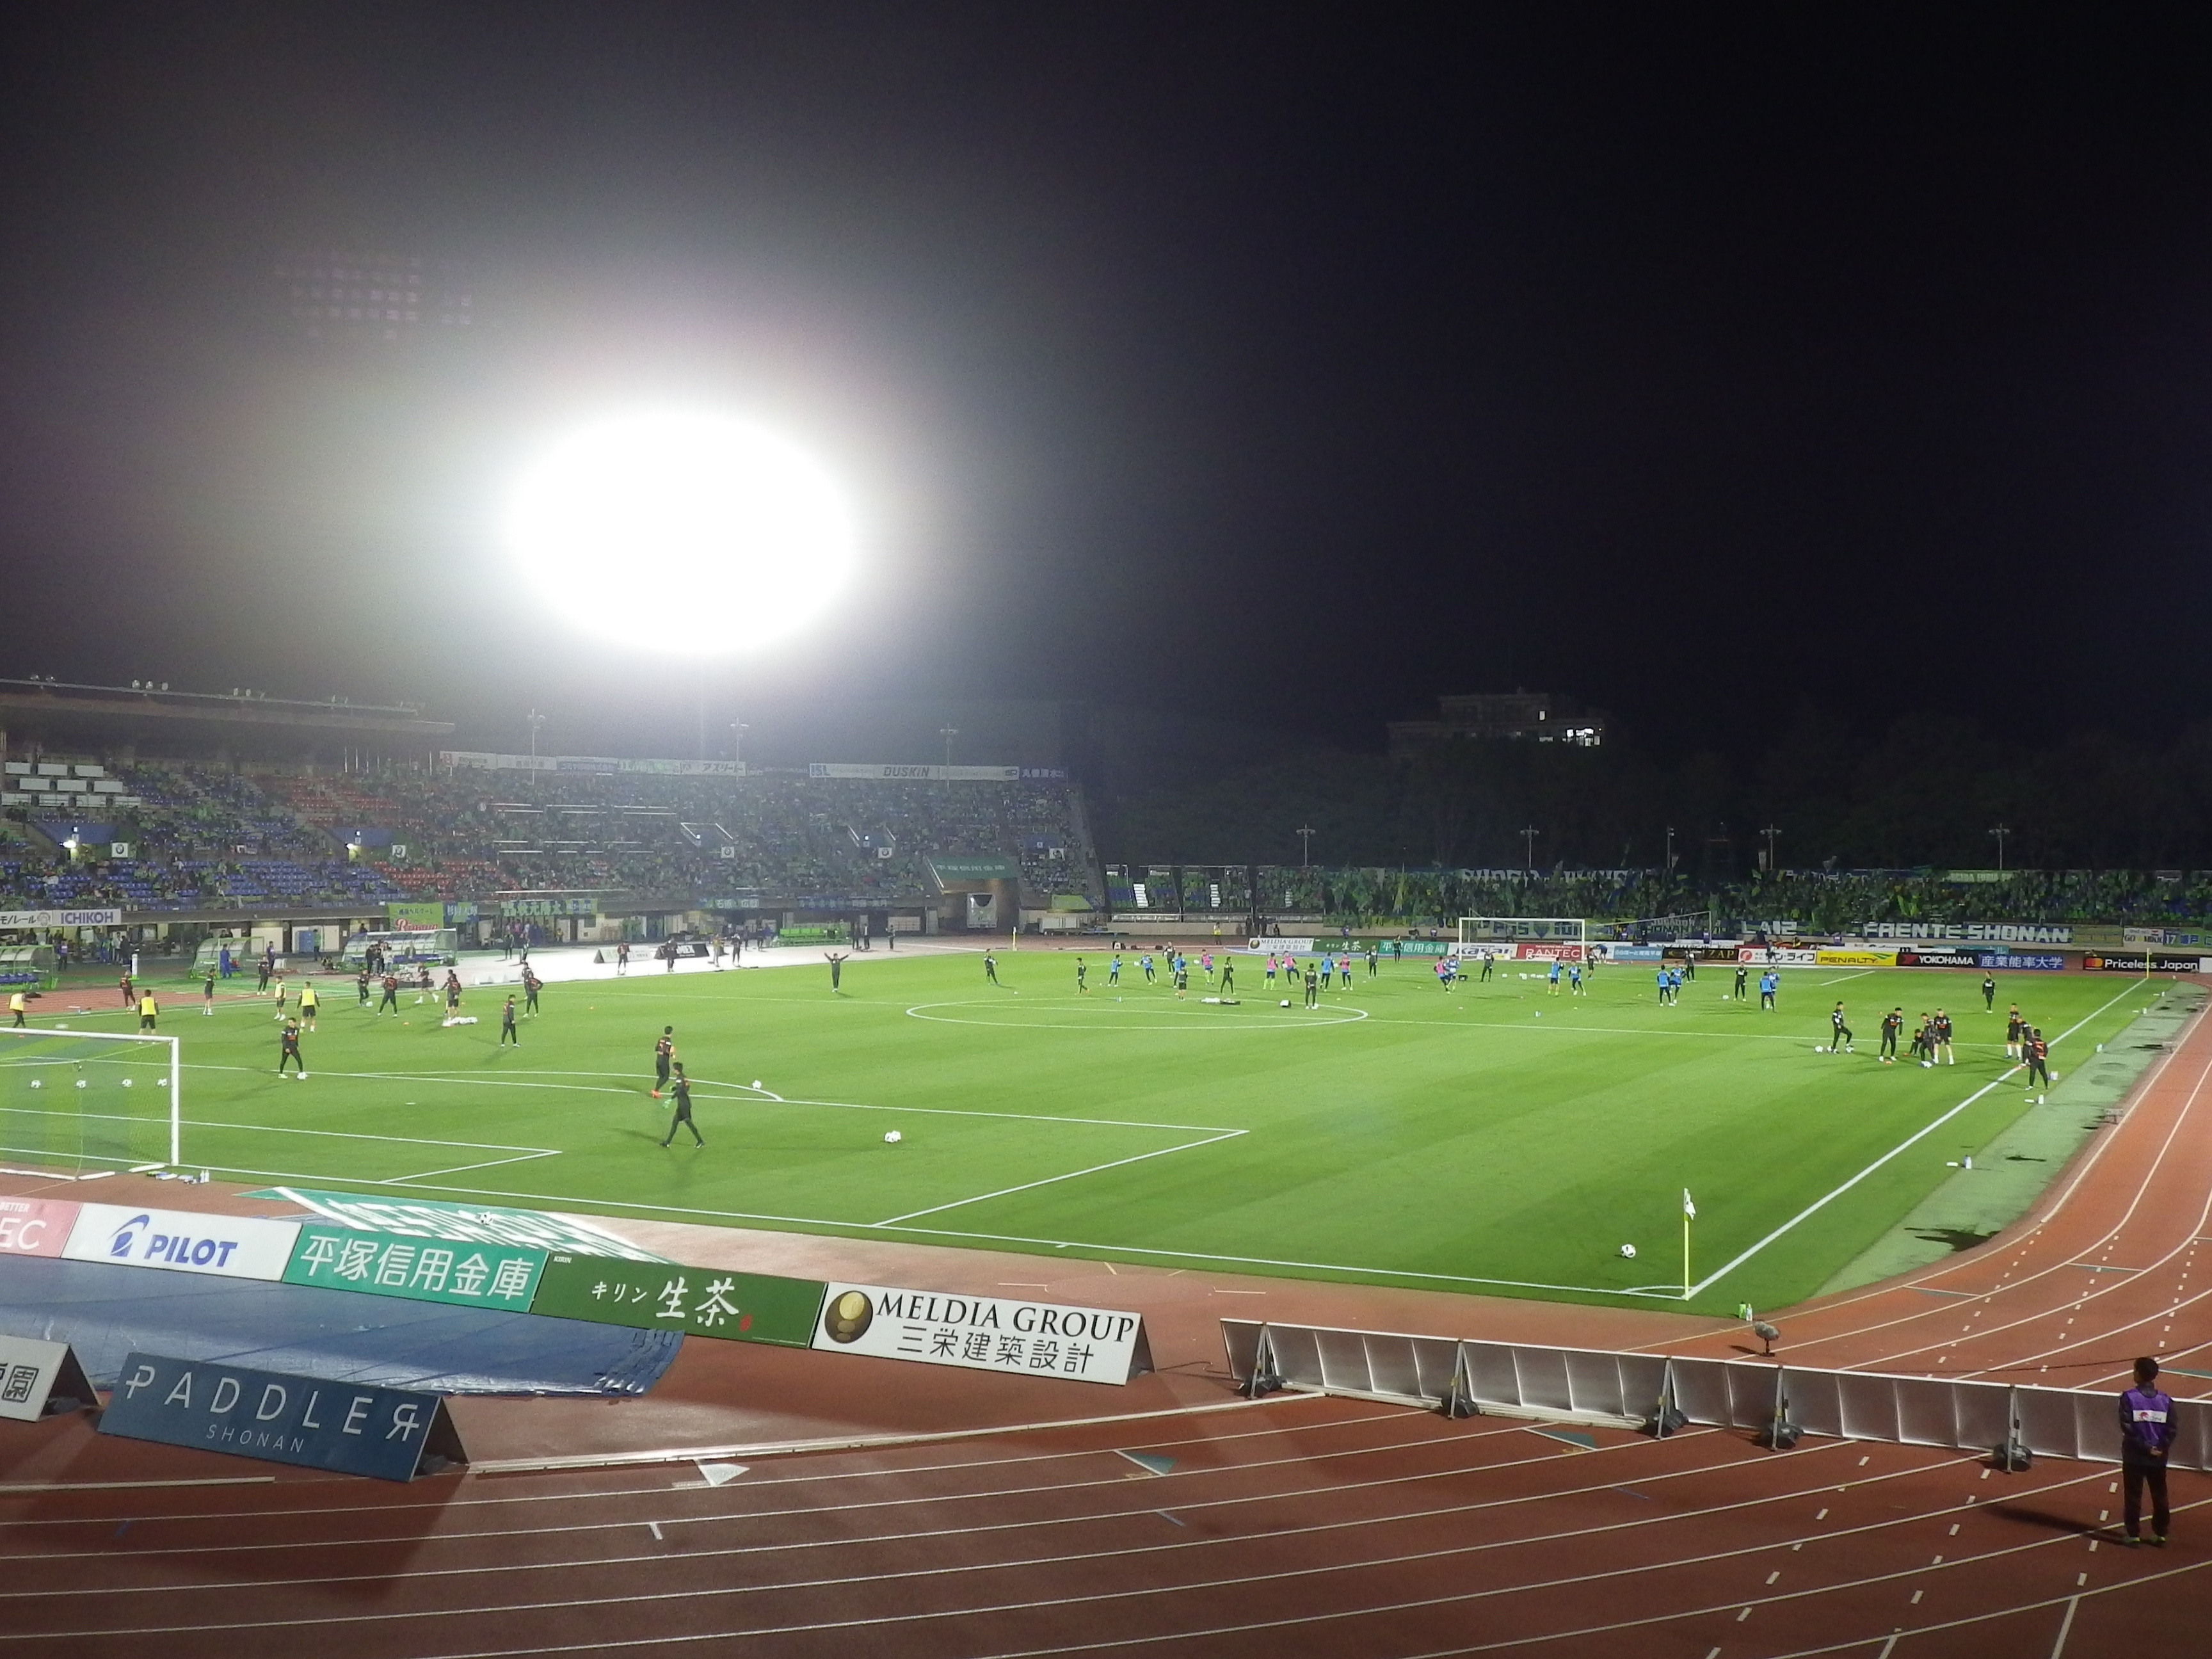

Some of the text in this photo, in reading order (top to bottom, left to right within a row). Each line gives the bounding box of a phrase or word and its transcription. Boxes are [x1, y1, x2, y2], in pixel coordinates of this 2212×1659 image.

[883, 767, 929, 778] DUSKIN
[61, 911, 113, 924] ICHIKOH
[1967, 924, 2070, 943] SHONAN
[1525, 948, 1580, 958] RANTEC
[1919, 956, 1974, 965] YOKOHAMA
[1981, 955, 2063, 969] 産業能率大学
[2104, 959, 2198, 971] Priceless Japan
[144, 1235, 238, 1267] PILOT
[300, 1235, 534, 1301] 平塚信用金庫
[592, 1276, 739, 1327] キリン 生茶
[876, 1292, 1134, 1343] MELDIA GROUP
[897, 1326, 1094, 1374] 三栄建築設計
[205, 1425, 304, 1454] SHONAN
